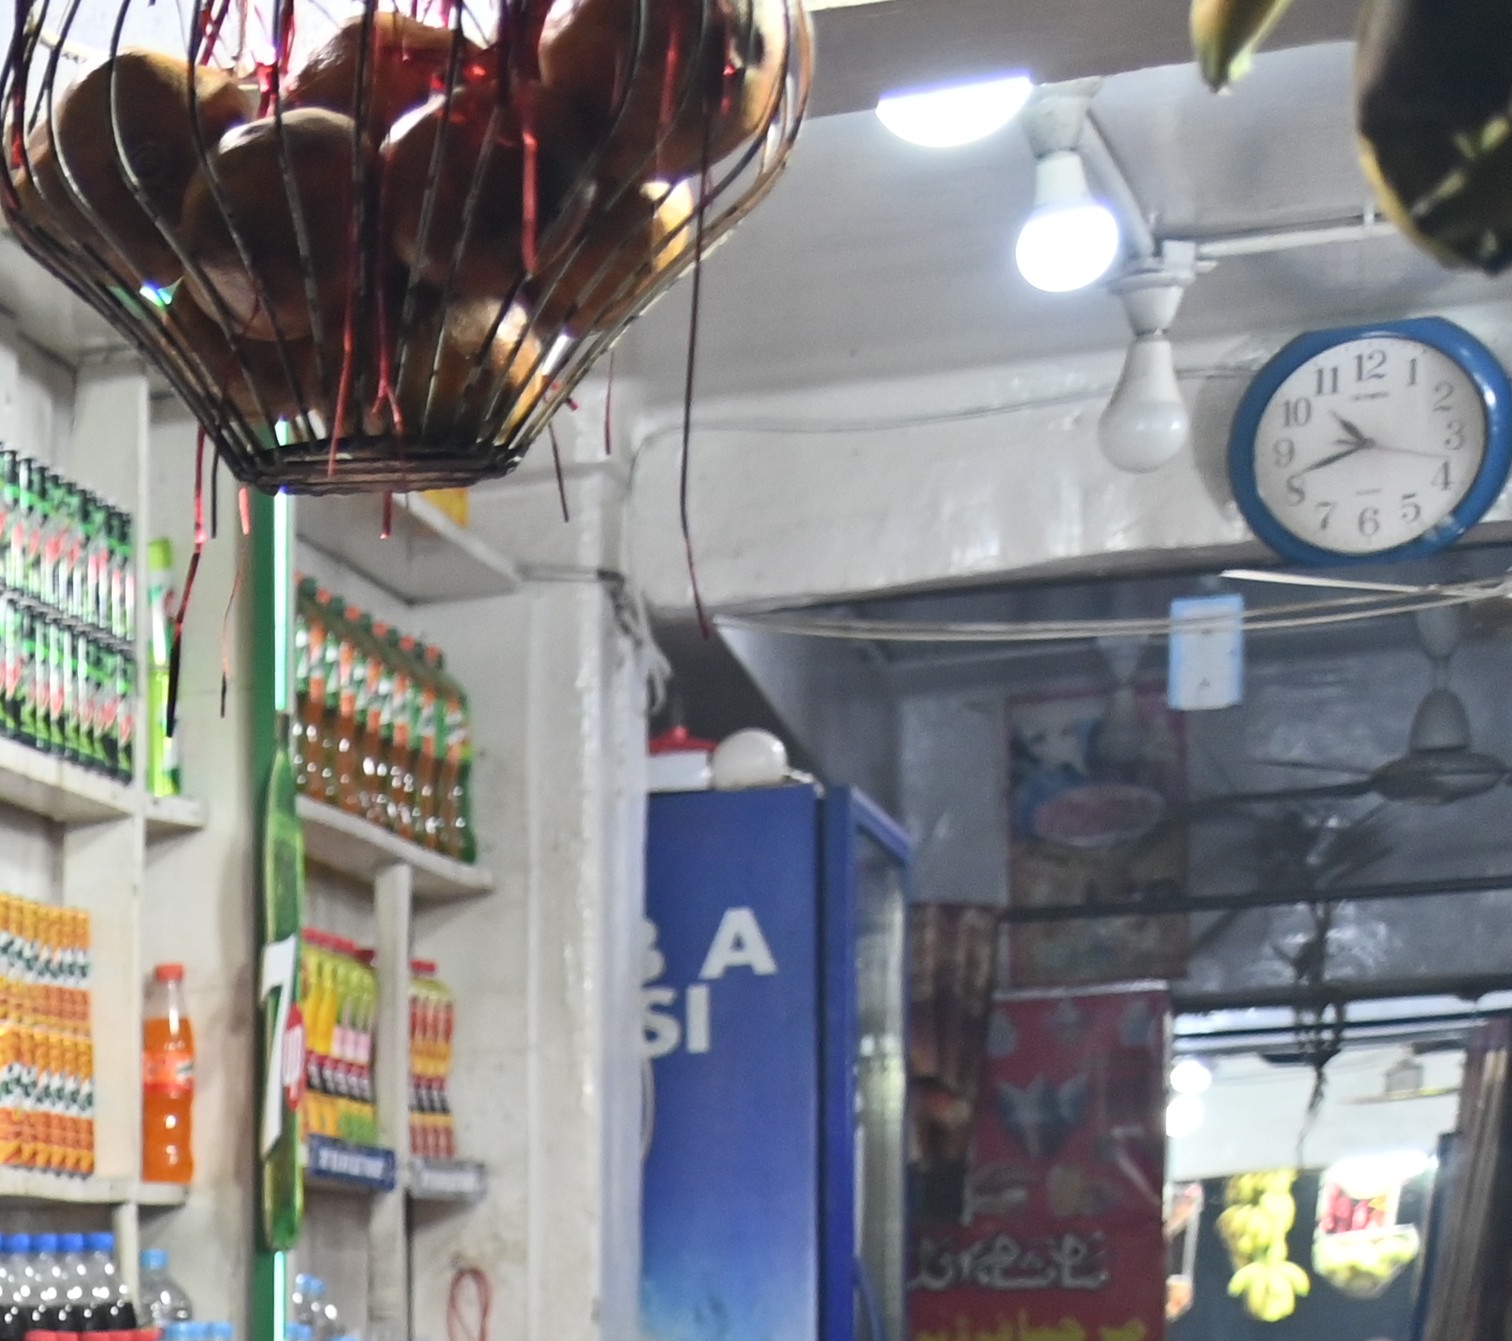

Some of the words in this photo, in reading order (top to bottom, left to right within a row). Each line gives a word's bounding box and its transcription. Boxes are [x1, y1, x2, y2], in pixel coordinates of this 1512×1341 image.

[1315, 366, 1340, 396] 11
[1353, 349, 1388, 382] 12
[1406, 358, 1419, 387] 1
[1433, 381, 1456, 413] 2
[1282, 397, 1312, 429] 10
[1444, 421, 1466, 451] 3
[1272, 438, 1295, 469] 9
[1285, 475, 1307, 507] 8
[1432, 460, 1455, 491] 4
[1315, 501, 1337, 531] 7
[1358, 506, 1381, 537] 6
[1401, 493, 1422, 523] 5
